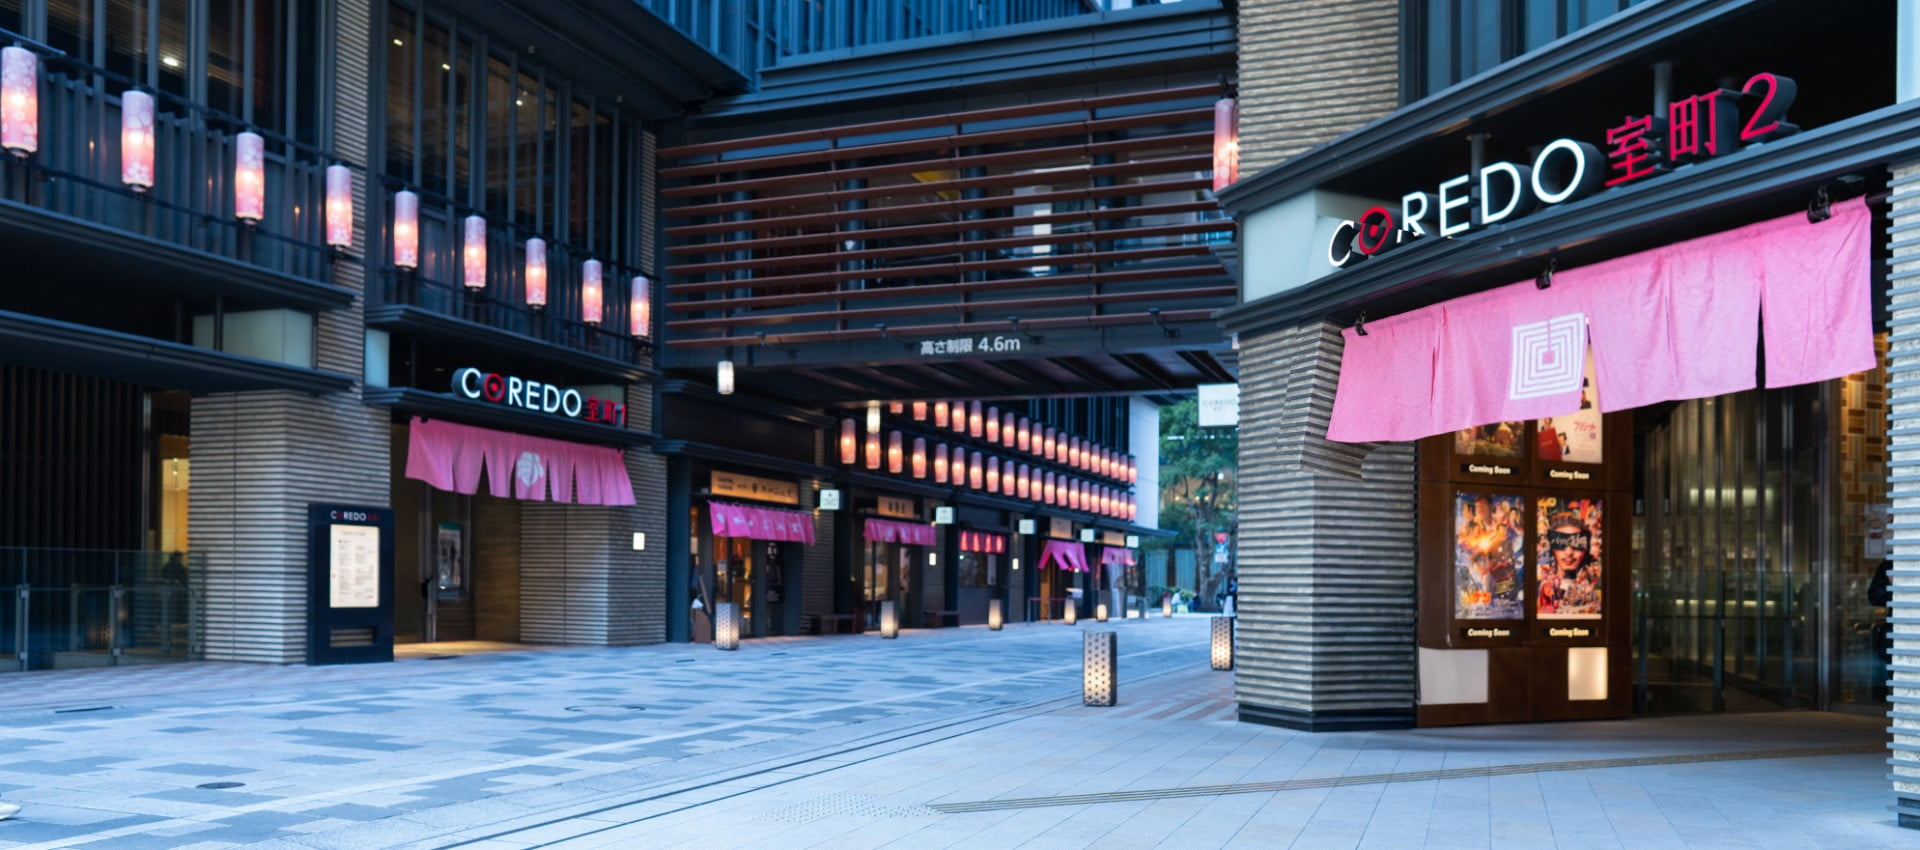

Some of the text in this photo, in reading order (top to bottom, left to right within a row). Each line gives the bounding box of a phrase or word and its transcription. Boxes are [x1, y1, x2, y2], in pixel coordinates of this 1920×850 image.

[1327, 138, 1586, 268] COREDO
[920, 336, 1021, 356] 高さ制限 4.6m
[460, 367, 583, 418] COREDO
[1469, 464, 1511, 475] Coming Soon
[1550, 469, 1590, 480] Coming Soon
[330, 510, 367, 521] COREDO
[1468, 628, 1510, 638] Coming Soon
[1549, 628, 1590, 638] Coming Soon
